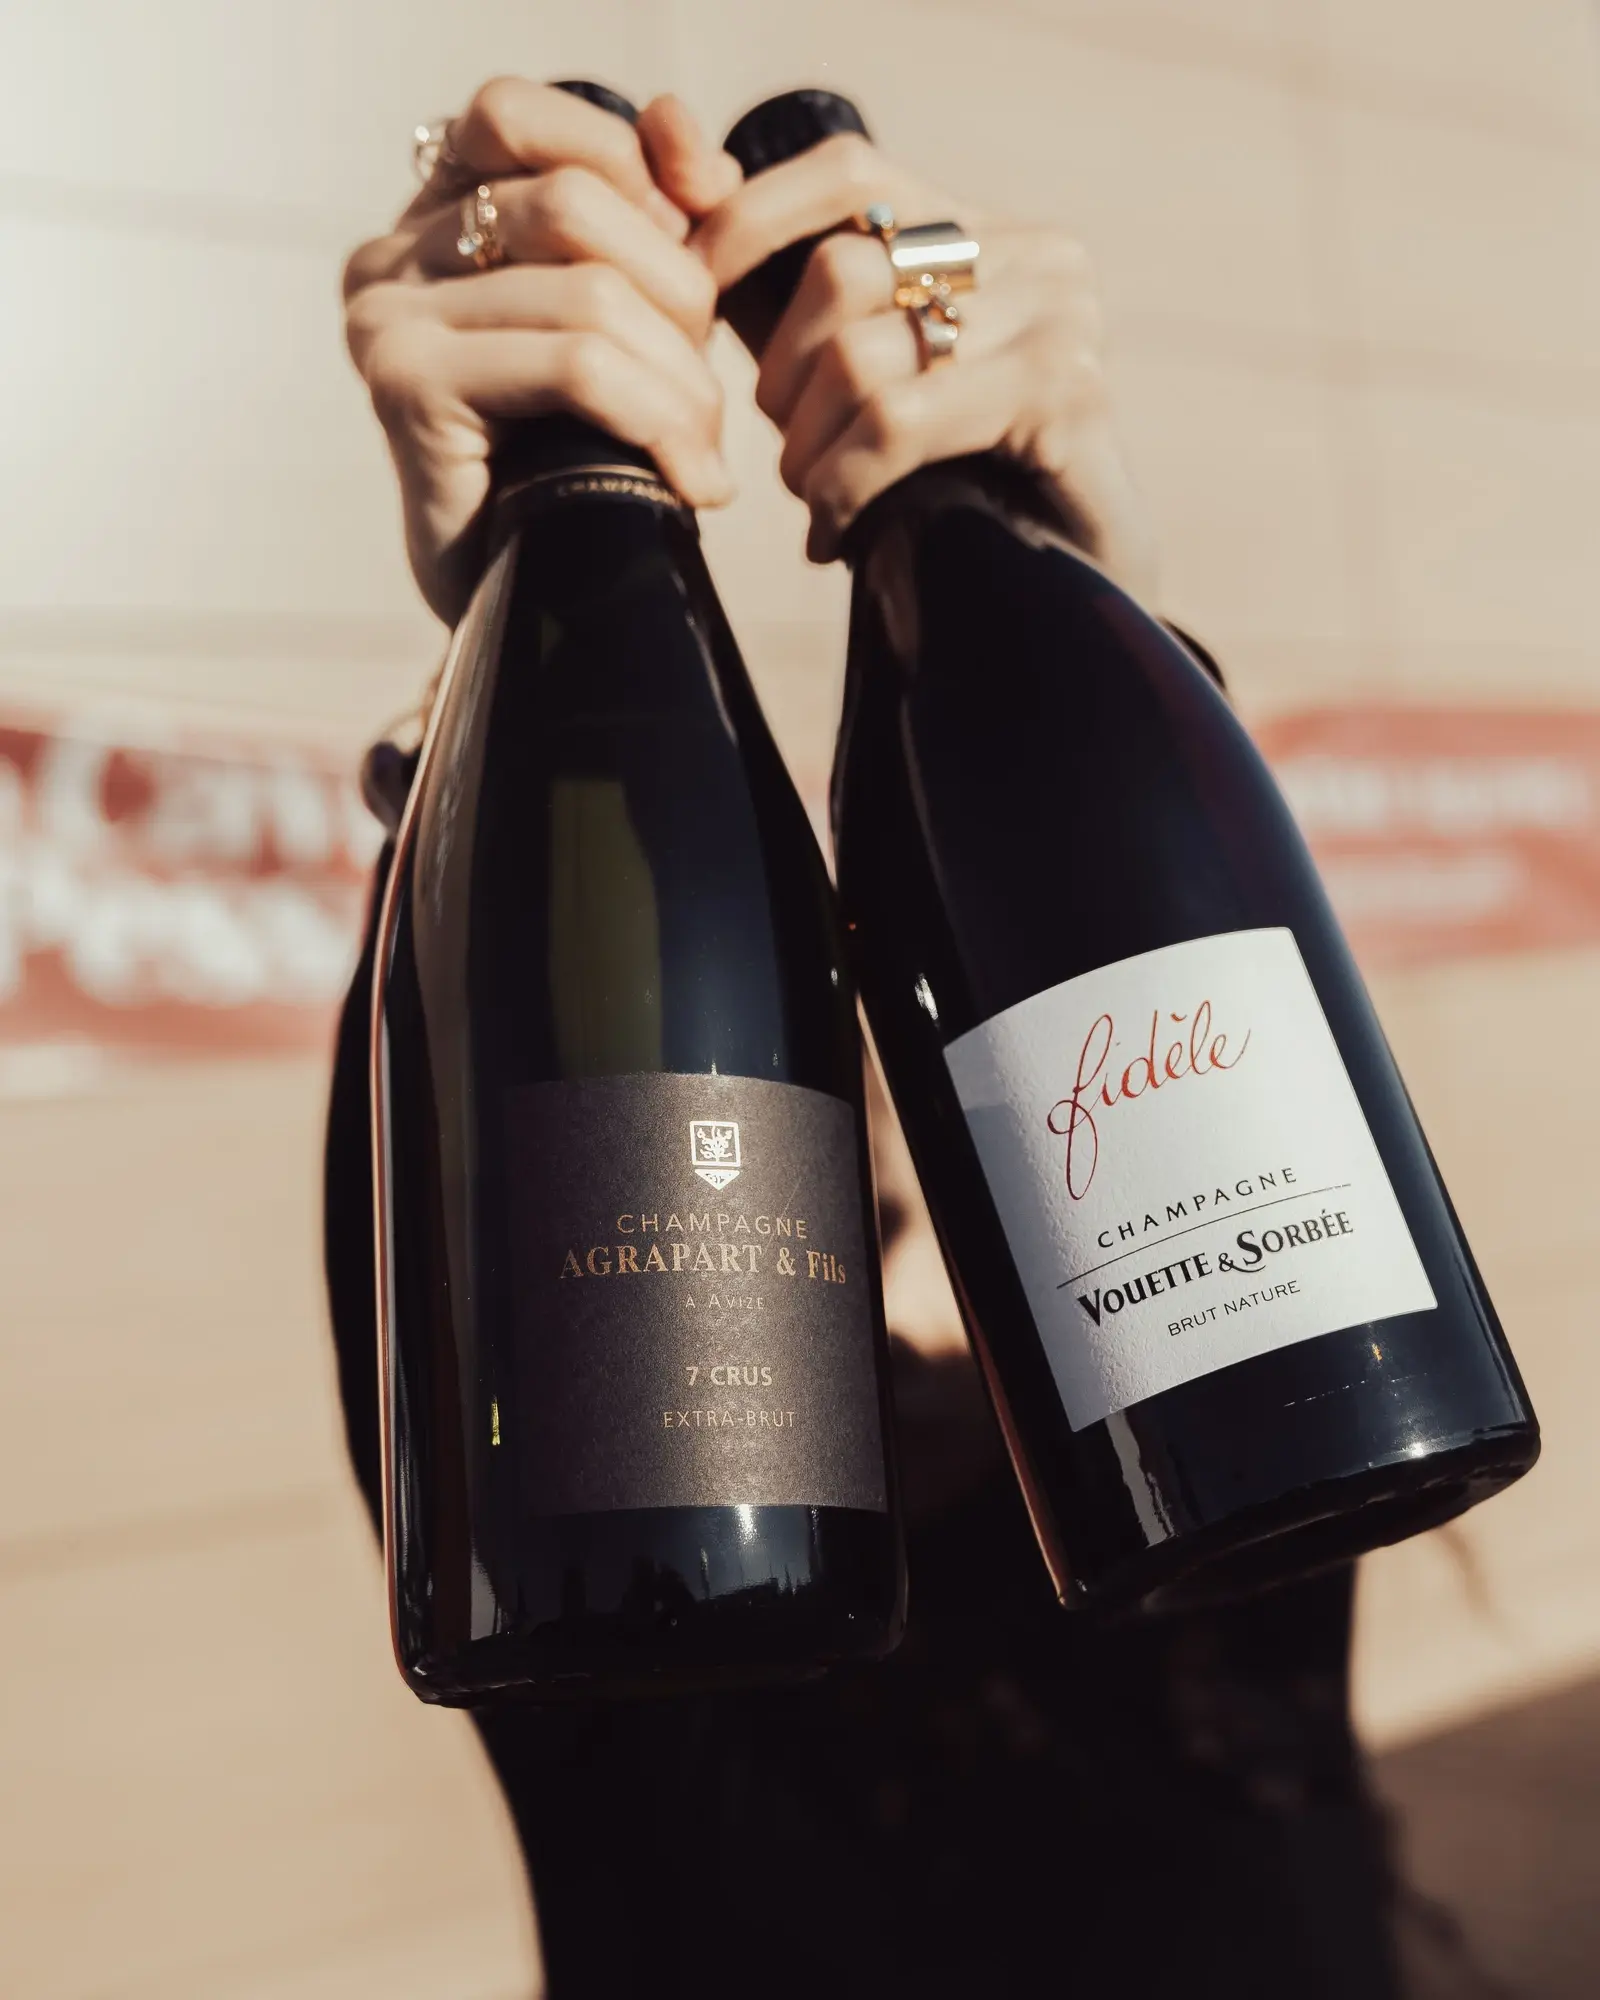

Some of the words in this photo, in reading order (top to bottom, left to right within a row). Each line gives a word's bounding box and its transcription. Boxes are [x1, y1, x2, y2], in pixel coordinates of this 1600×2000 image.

[1096, 1166, 1297, 1249] CHAMPAGNE
[615, 1212, 808, 1240] CHAMPAGNE
[559, 1242, 763, 1280] AGRAPART
[775, 1246, 797, 1276] &
[805, 1249, 847, 1285] Fils
[1076, 1251, 1213, 1327] VOUETTE
[1236, 1208, 1354, 1266] SORBÉE
[709, 1293, 765, 1310] AVIZE
[1167, 1306, 1217, 1337] BRUT
[1223, 1279, 1301, 1316] NATURE
[685, 1366, 699, 1386] 7
[710, 1365, 773, 1387] CRUS
[663, 1410, 796, 1428] EXTRA-BRUT
